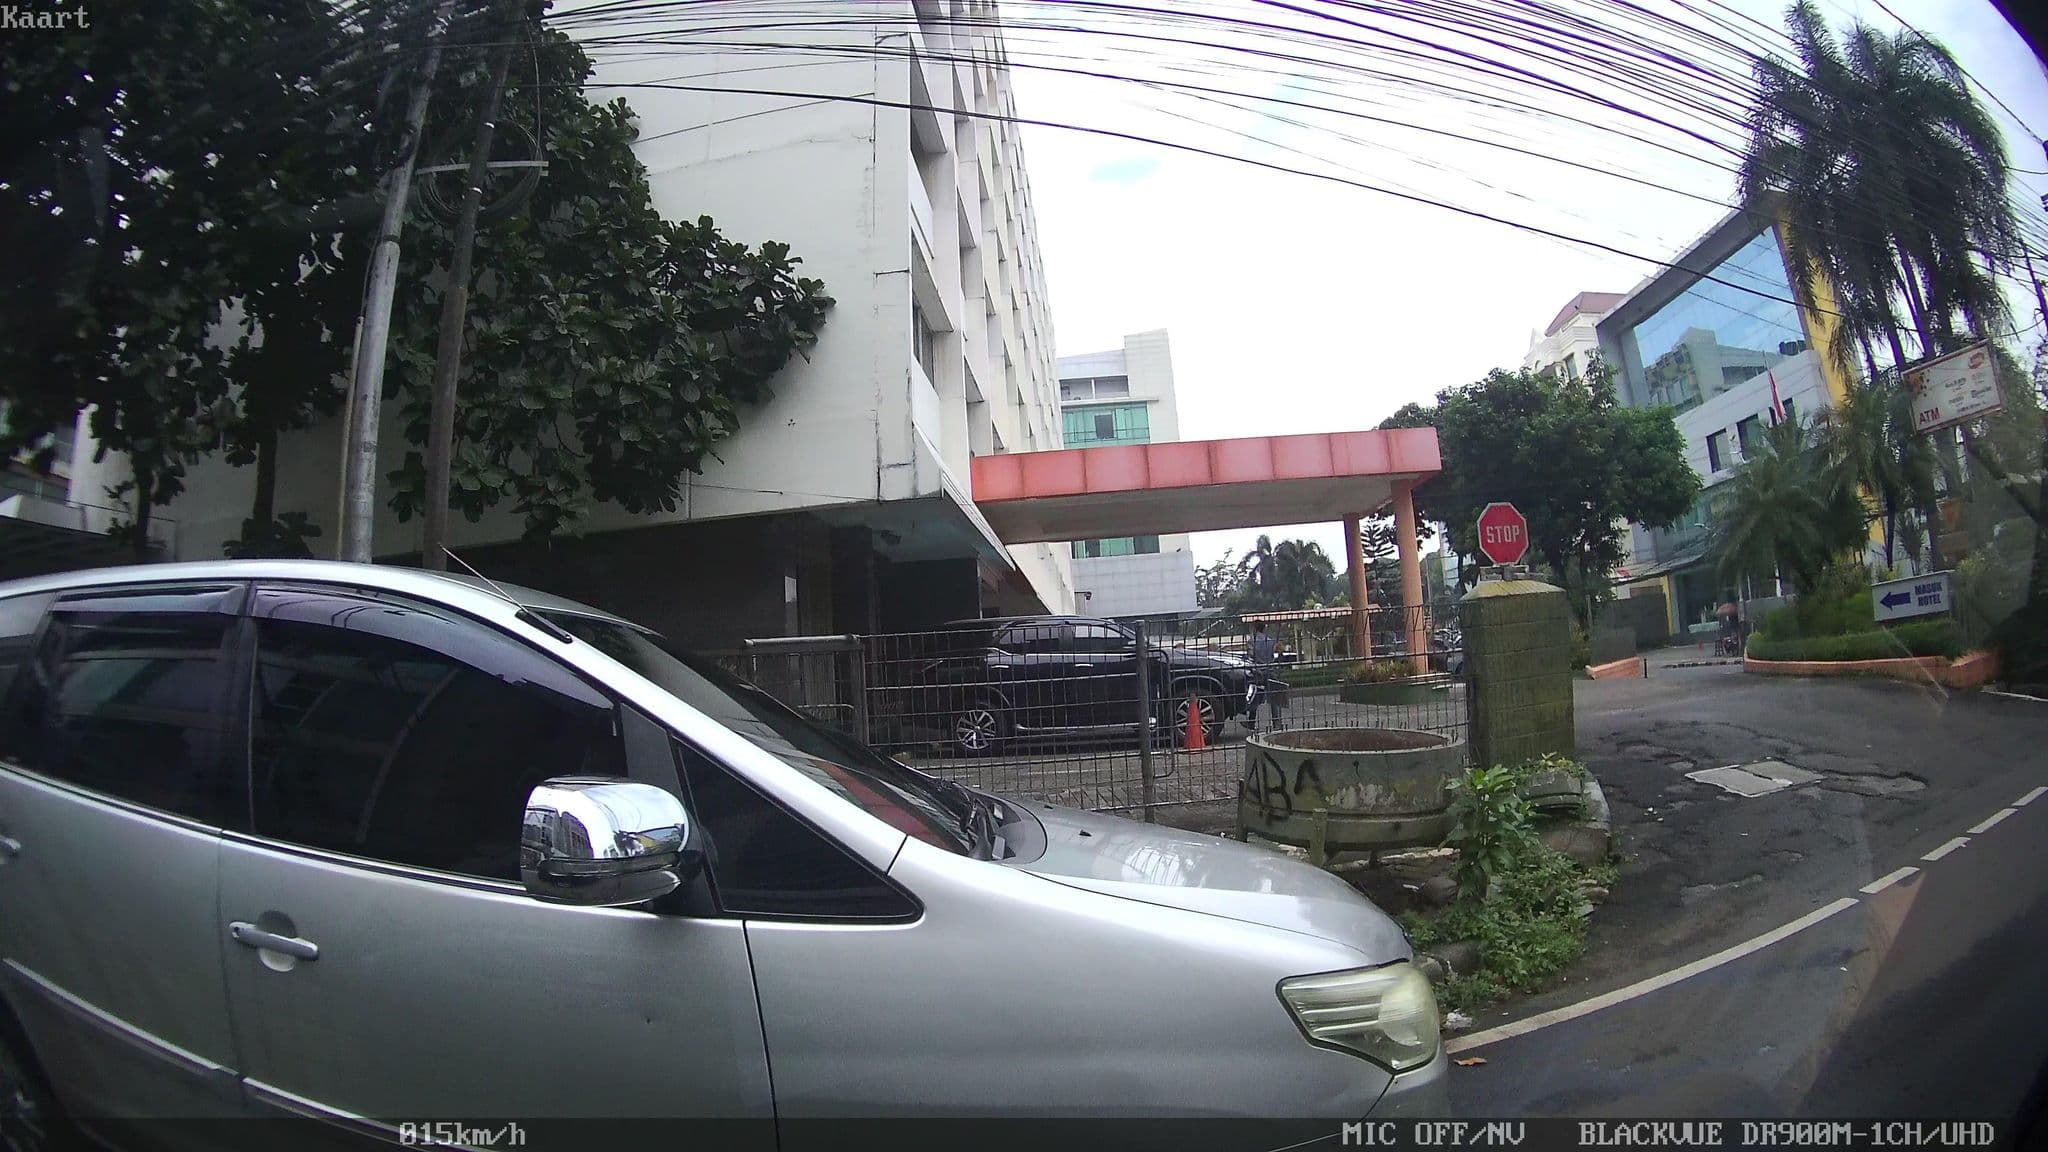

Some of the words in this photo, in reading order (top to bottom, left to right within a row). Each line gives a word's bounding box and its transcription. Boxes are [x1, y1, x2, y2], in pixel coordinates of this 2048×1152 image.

[1919, 408, 1940, 424] ATM
[1486, 525, 1520, 543] STOP
[1914, 582, 1942, 595] MASUK
[1918, 594, 1941, 606] HOTEL
